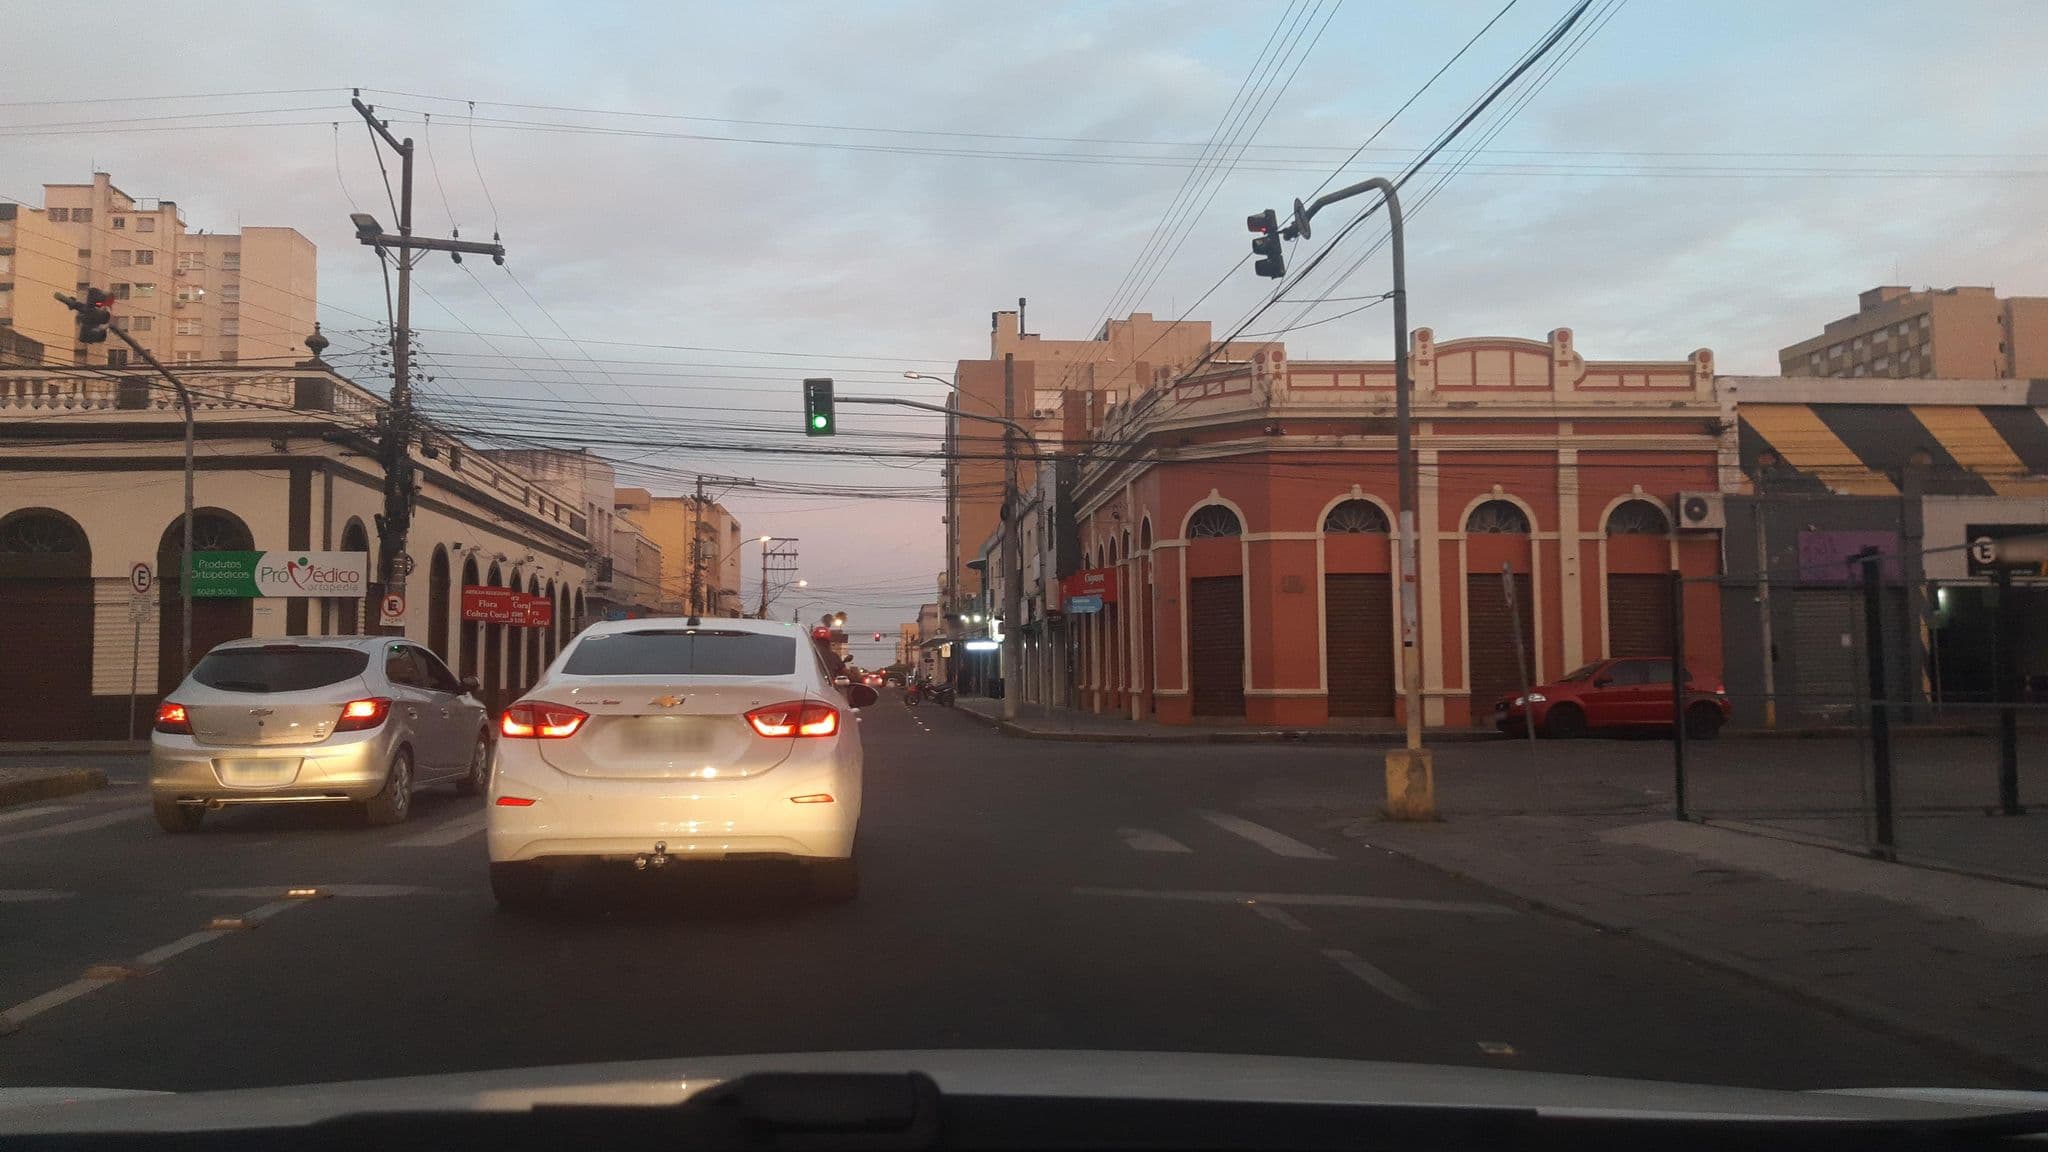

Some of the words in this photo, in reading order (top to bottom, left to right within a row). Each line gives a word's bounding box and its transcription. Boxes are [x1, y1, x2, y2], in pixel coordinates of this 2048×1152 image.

[198, 560, 242, 569] Produtos
[478, 599, 498, 608] Flora
[466, 609, 488, 618] Cobra
[490, 610, 509, 619] Coral
